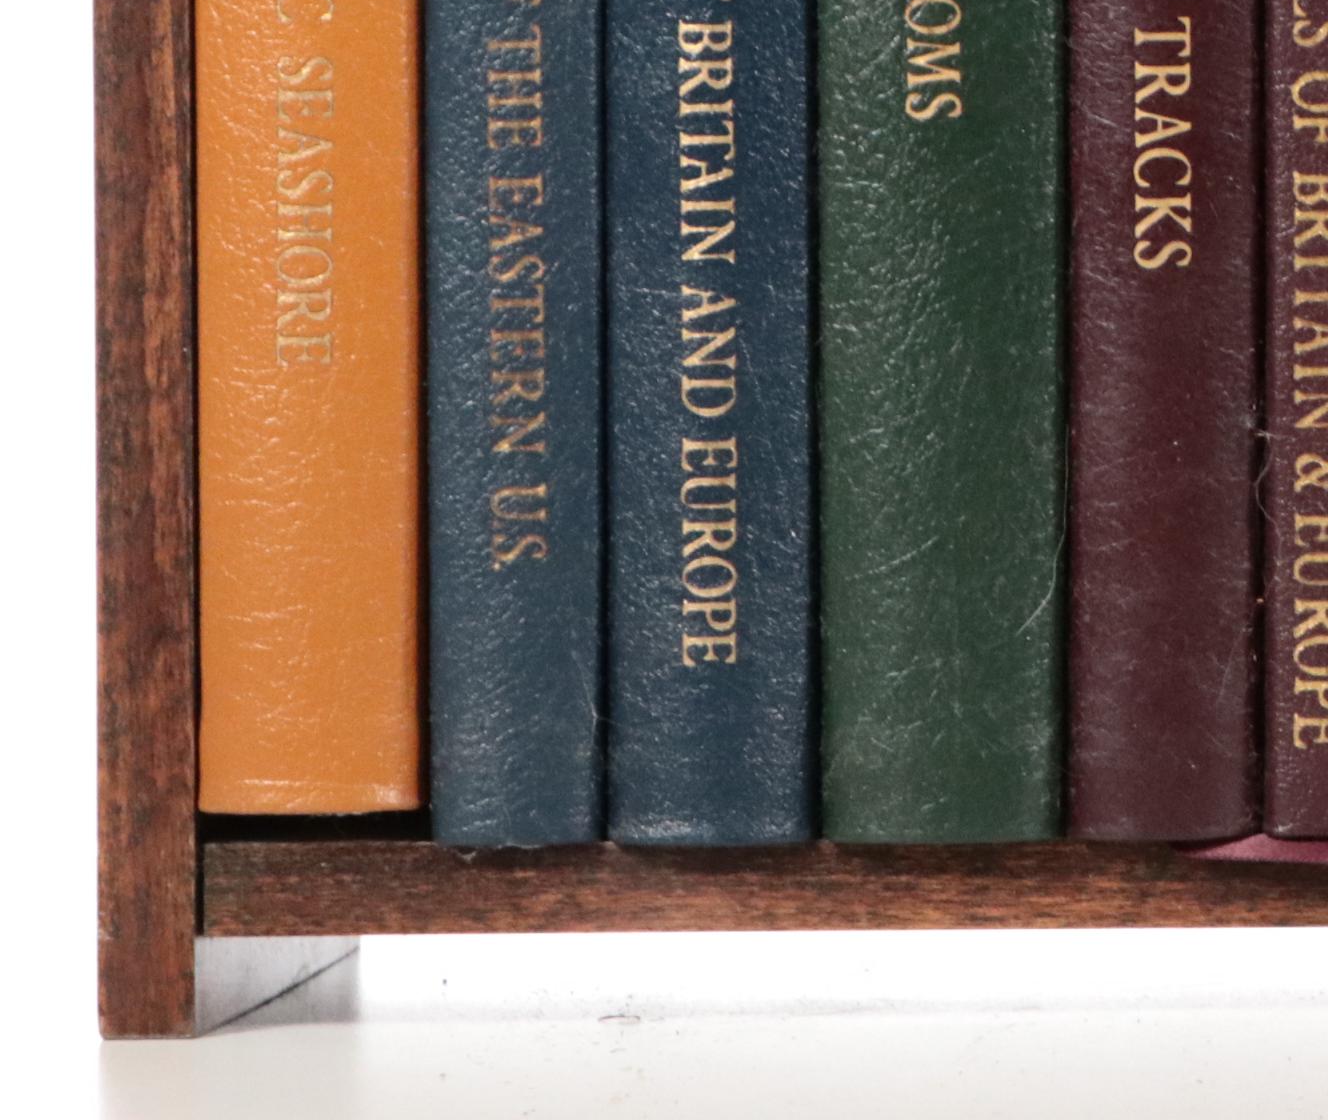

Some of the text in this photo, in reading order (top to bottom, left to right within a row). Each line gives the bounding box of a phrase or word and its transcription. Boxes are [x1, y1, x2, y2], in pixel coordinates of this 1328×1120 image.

[486, 26, 544, 151] THE
[677, 20, 736, 264] BRITAIN
[1133, 16, 1193, 270] TRACKS
[275, 54, 334, 368] SEASHORE
[488, 174, 547, 455] EASTERN
[680, 285, 737, 418] AND
[681, 436, 738, 668] EUROPE
